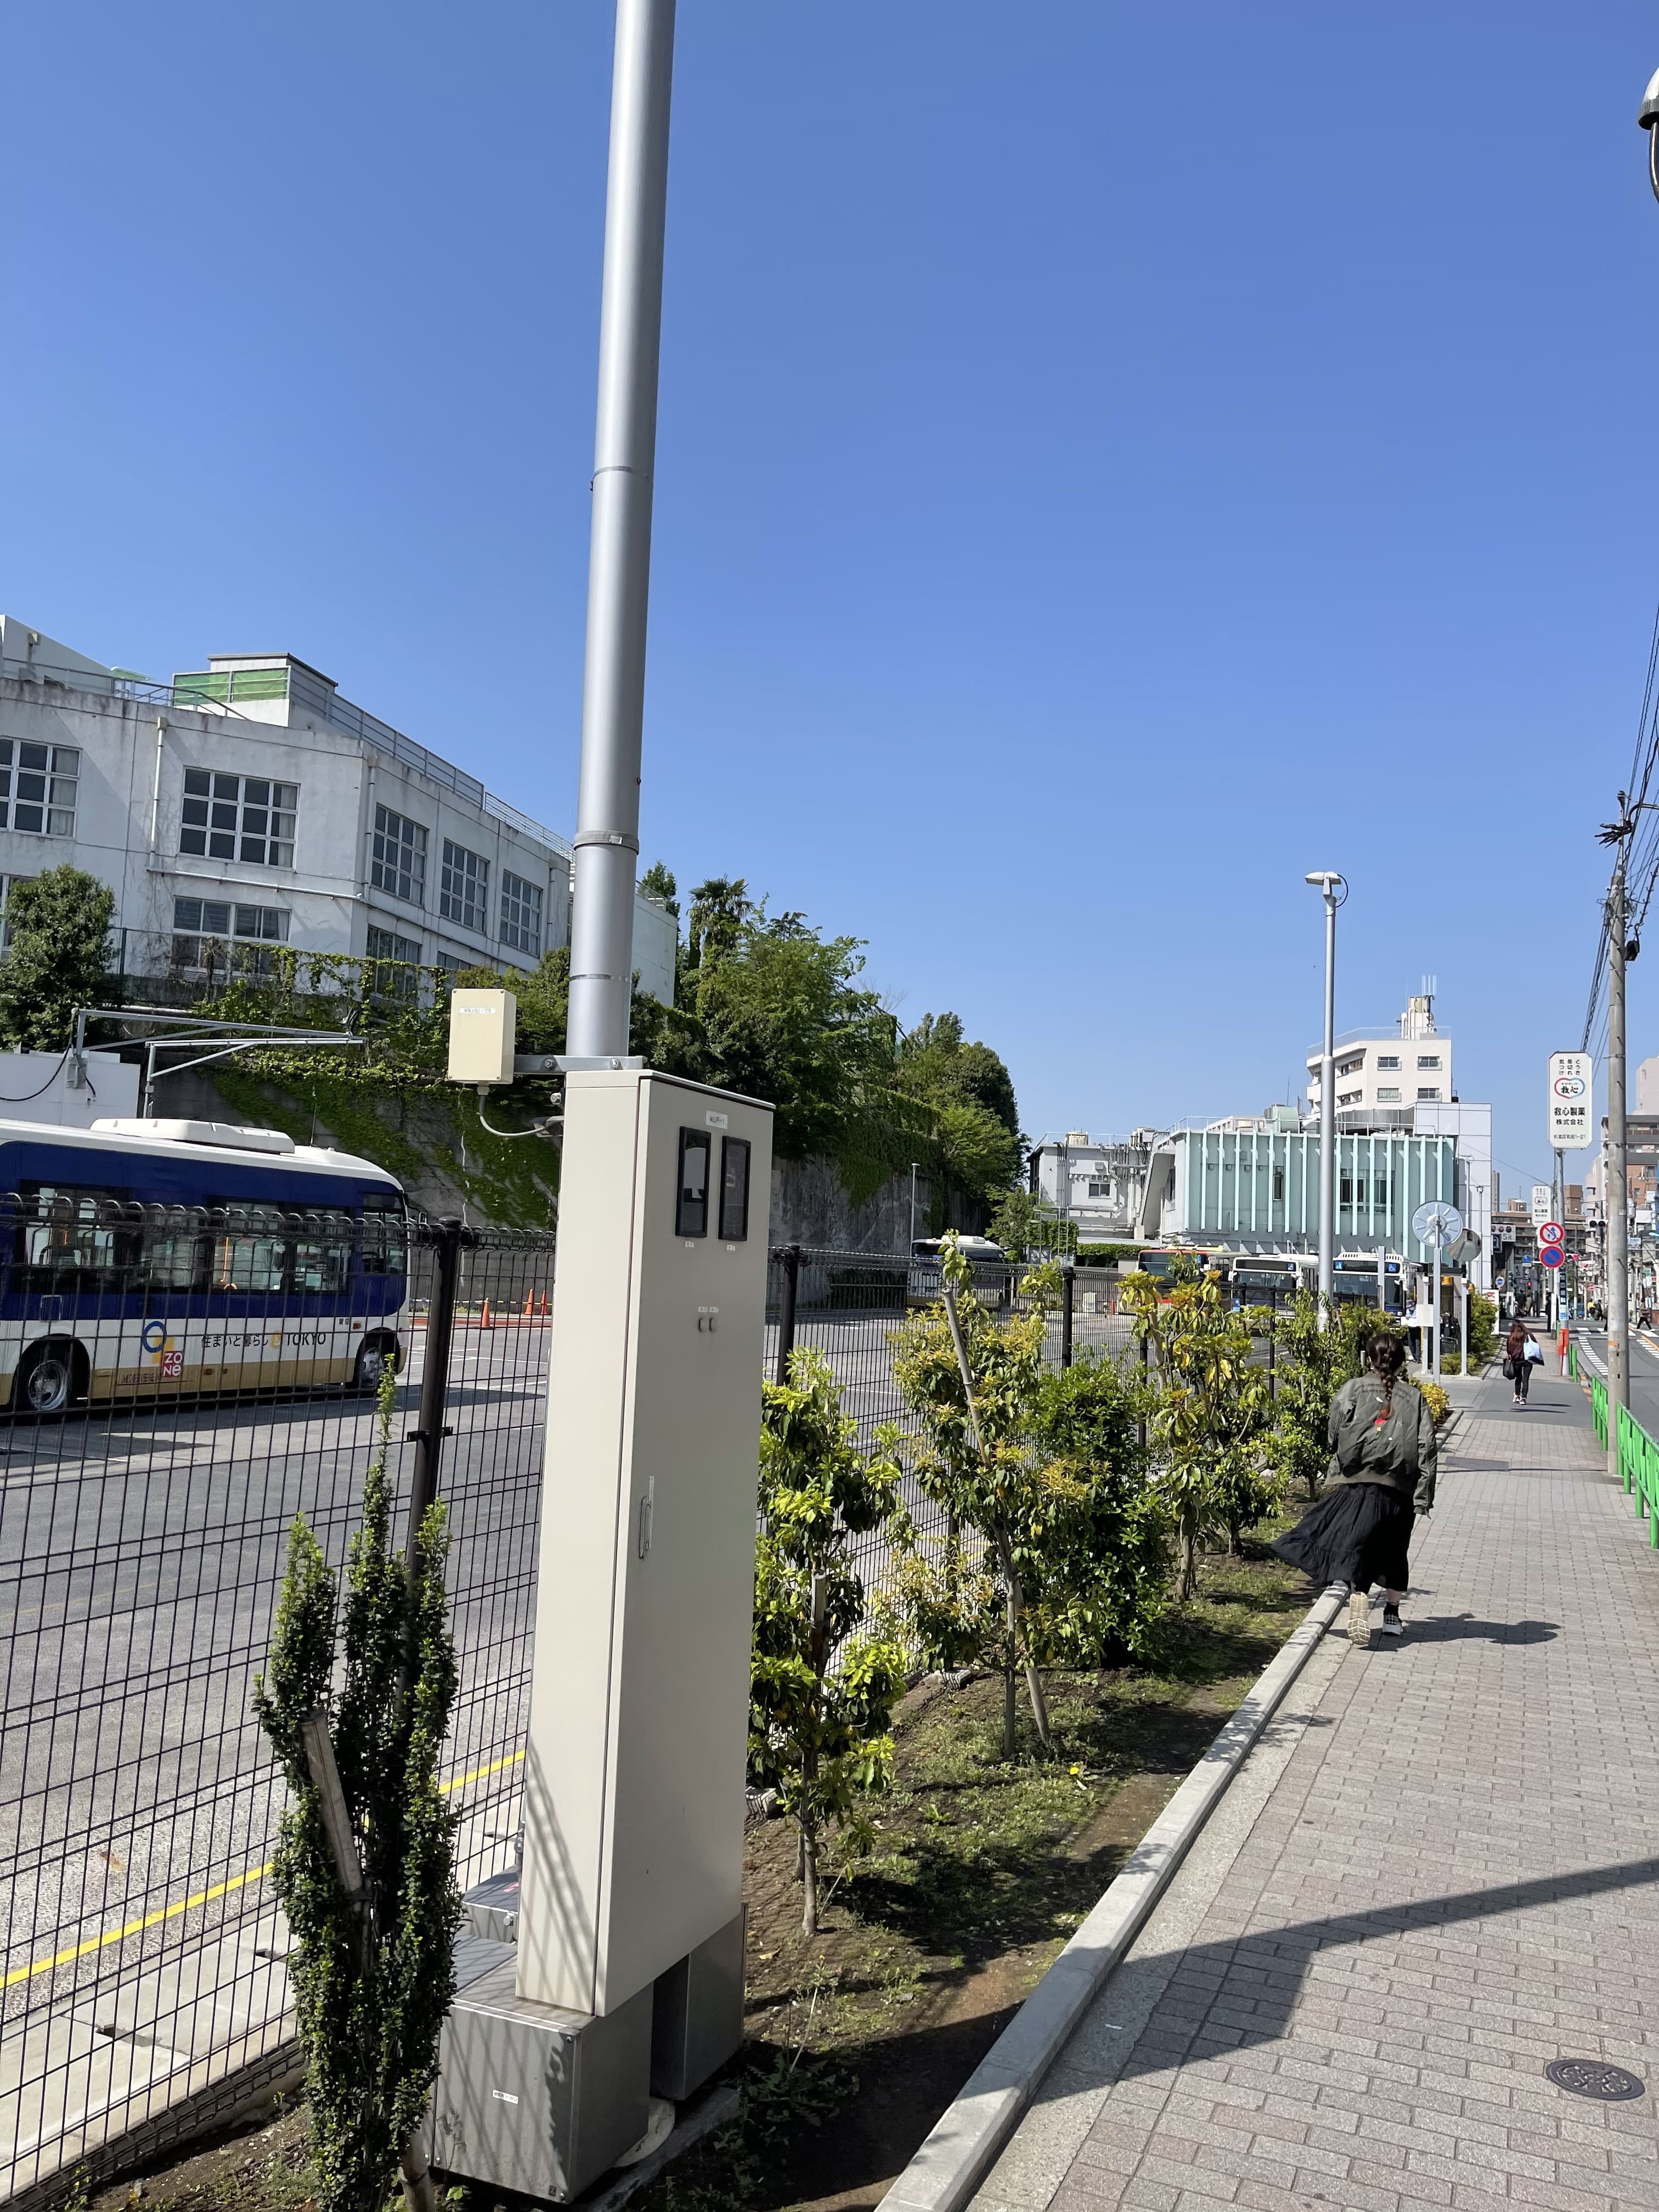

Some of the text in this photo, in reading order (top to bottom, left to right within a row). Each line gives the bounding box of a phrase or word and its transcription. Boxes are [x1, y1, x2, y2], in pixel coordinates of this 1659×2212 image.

[1561, 1086, 1579, 1094] 救心
[1554, 1107, 1585, 1116] 救心製薬
[286, 1333, 326, 1346] TOKYO
